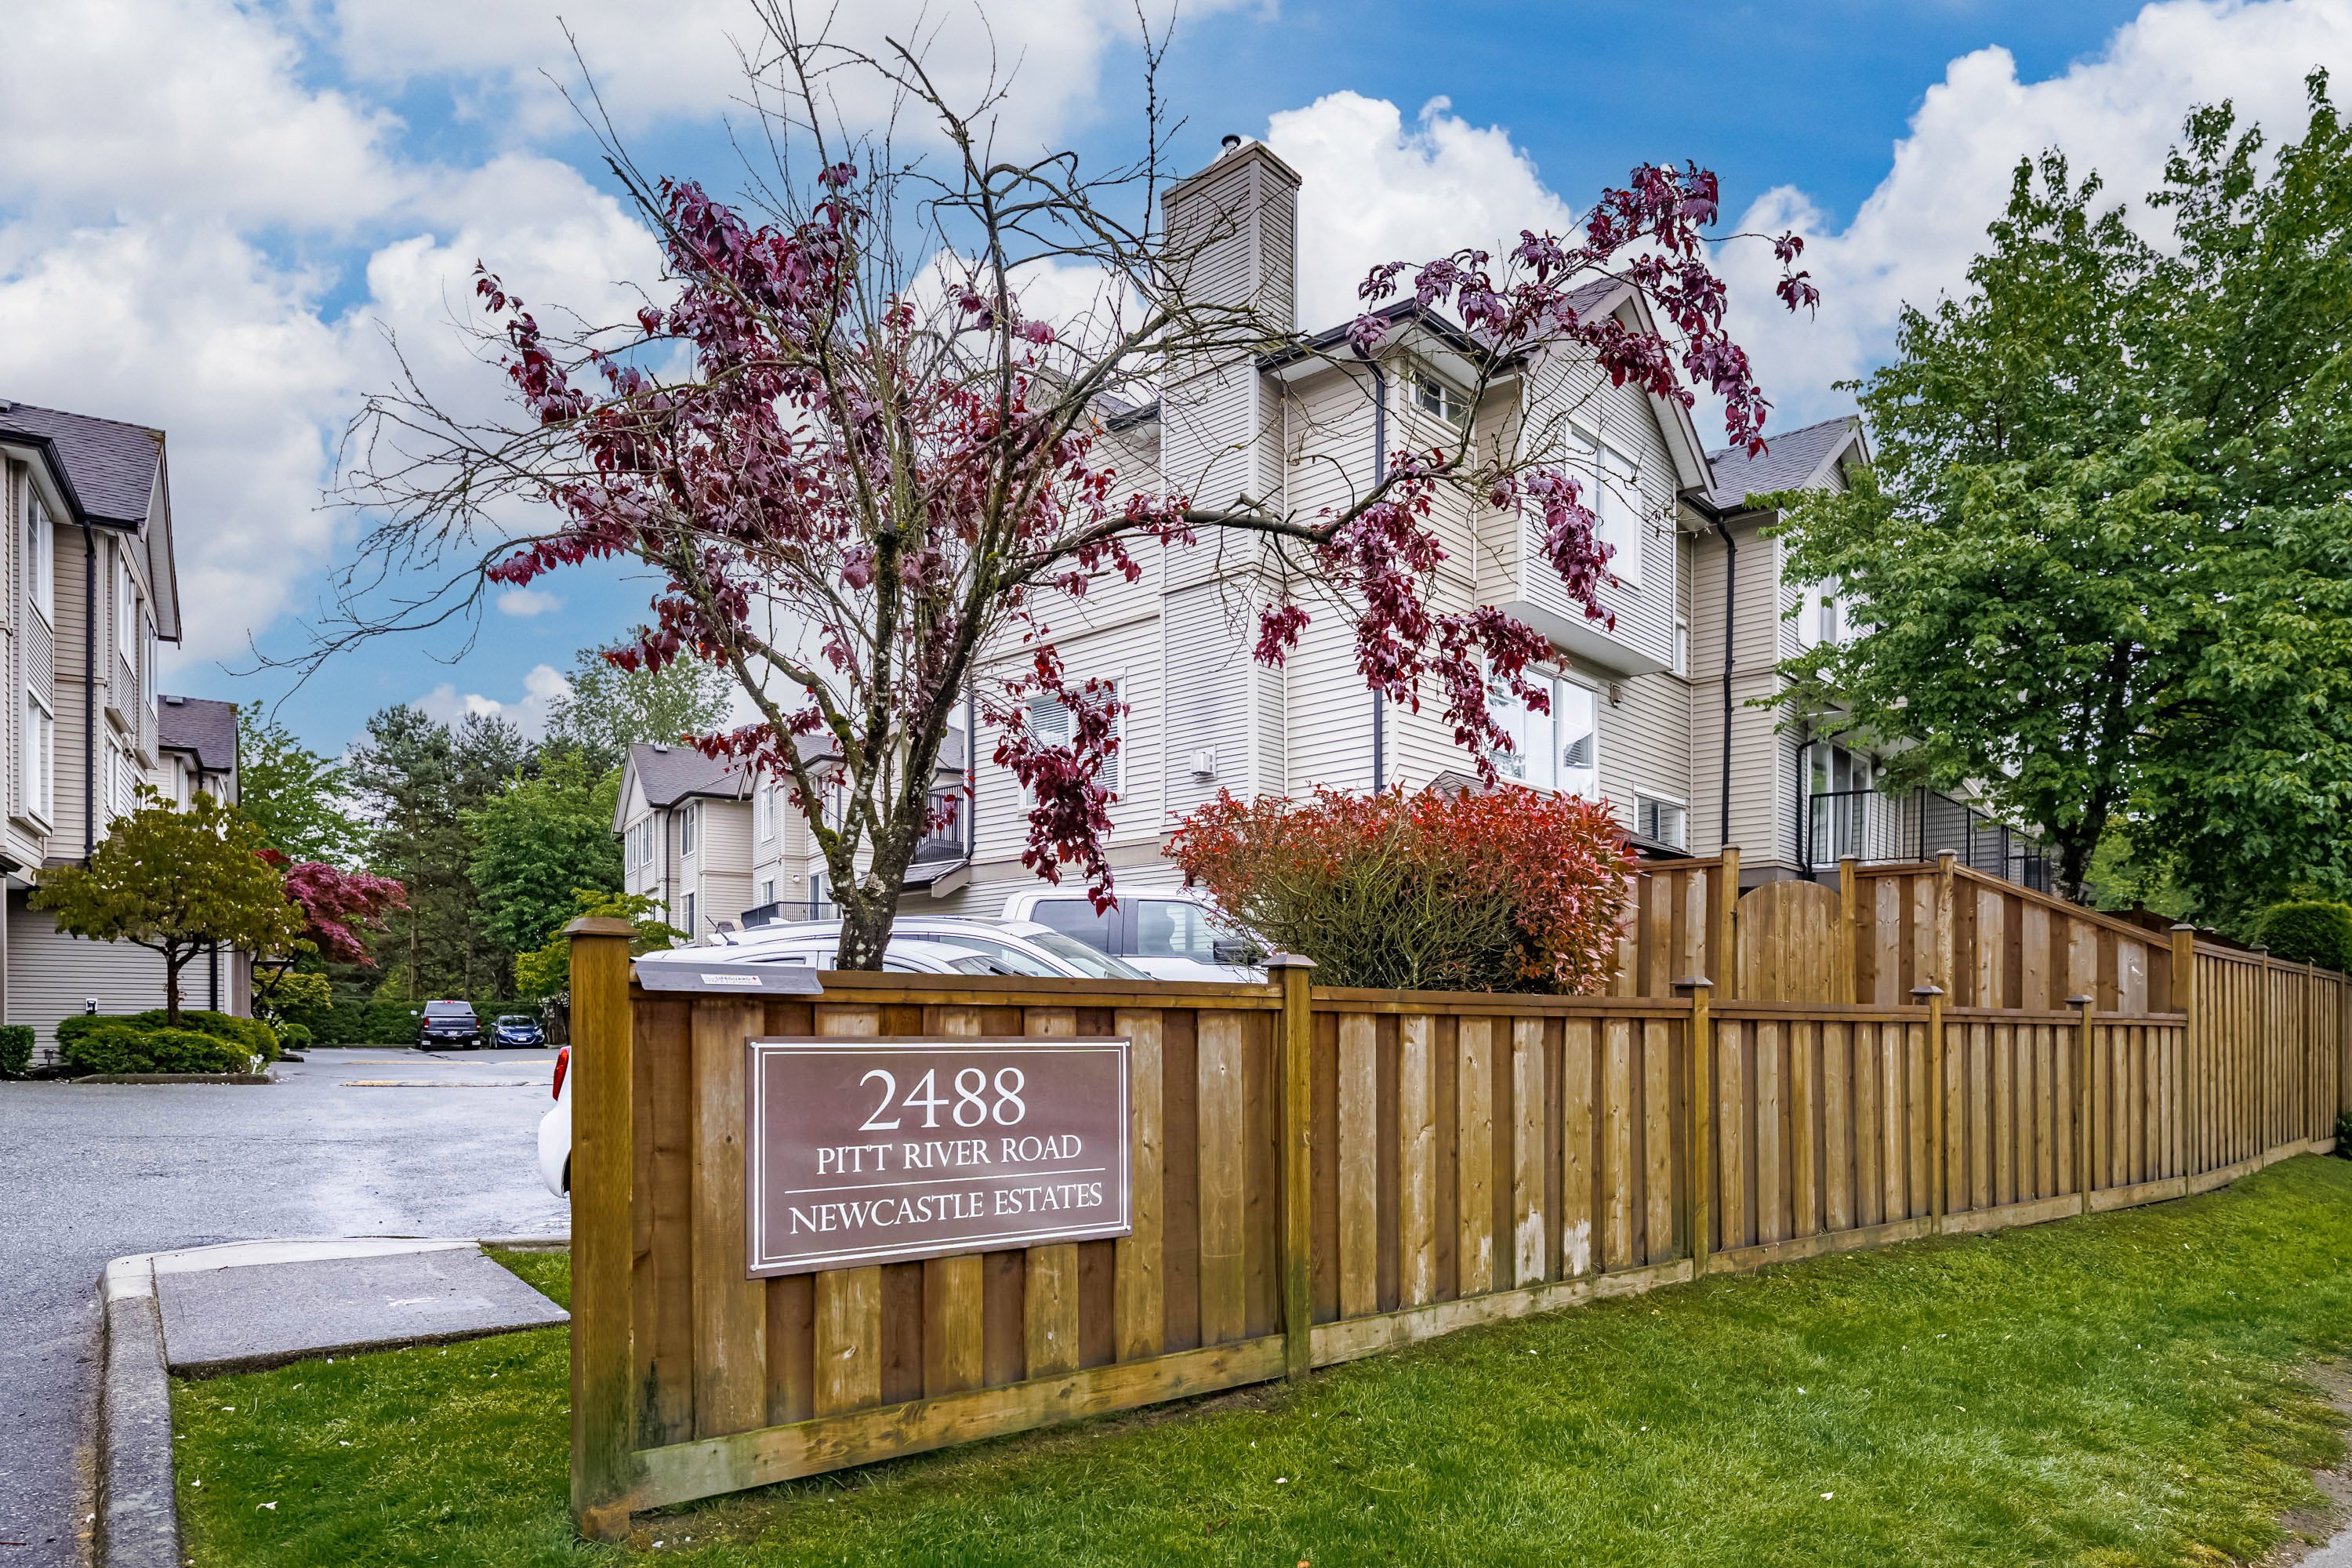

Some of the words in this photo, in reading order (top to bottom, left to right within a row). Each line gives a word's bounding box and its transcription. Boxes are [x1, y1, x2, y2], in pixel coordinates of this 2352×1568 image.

[858, 1067, 1025, 1131] 2488
[816, 1143, 893, 1175] PITT
[902, 1139, 992, 1170] RIVER
[1000, 1134, 1082, 1163] ROAD
[788, 1191, 985, 1235] NEWCASTLE
[993, 1181, 1103, 1216] ESTATES
